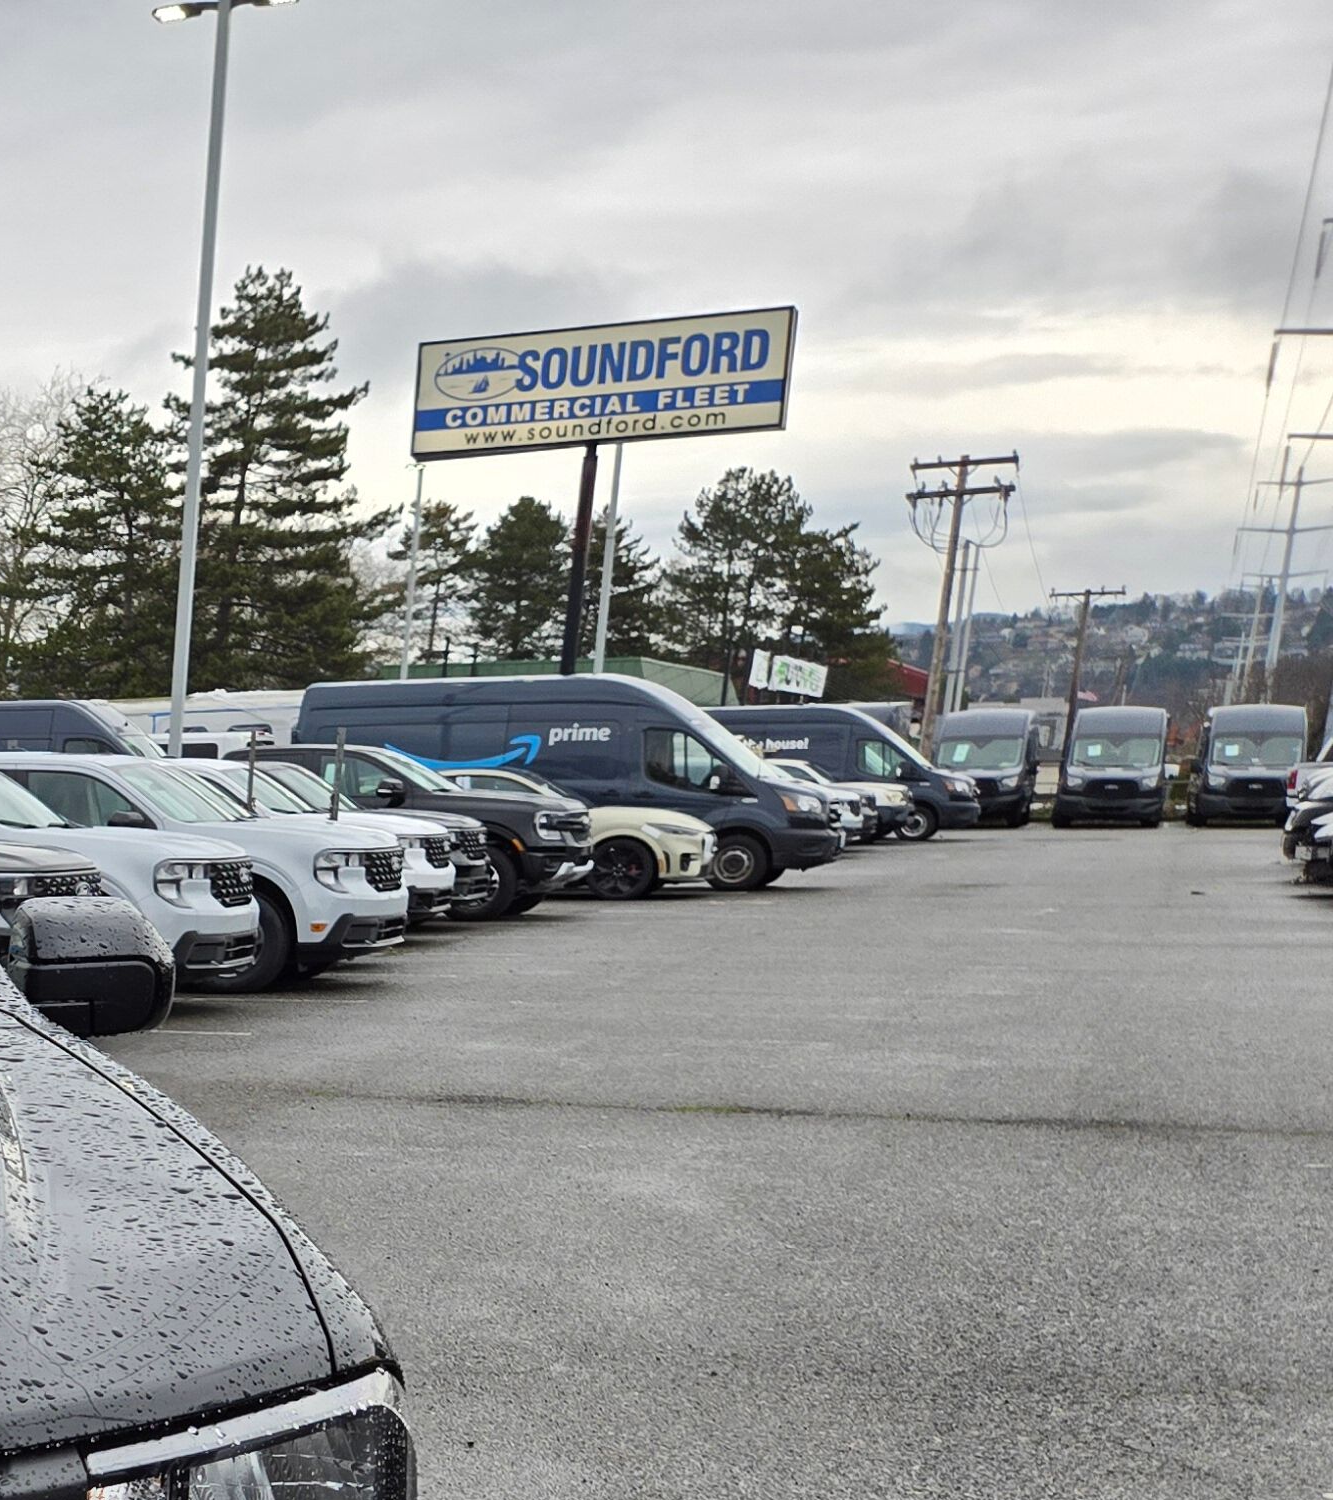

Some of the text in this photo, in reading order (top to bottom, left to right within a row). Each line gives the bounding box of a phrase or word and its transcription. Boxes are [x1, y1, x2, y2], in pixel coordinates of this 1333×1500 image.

[445, 384, 751, 428] COMMERCIAL FLEET
[464, 412, 727, 446] www.soundford.com
[548, 722, 612, 747] prime
